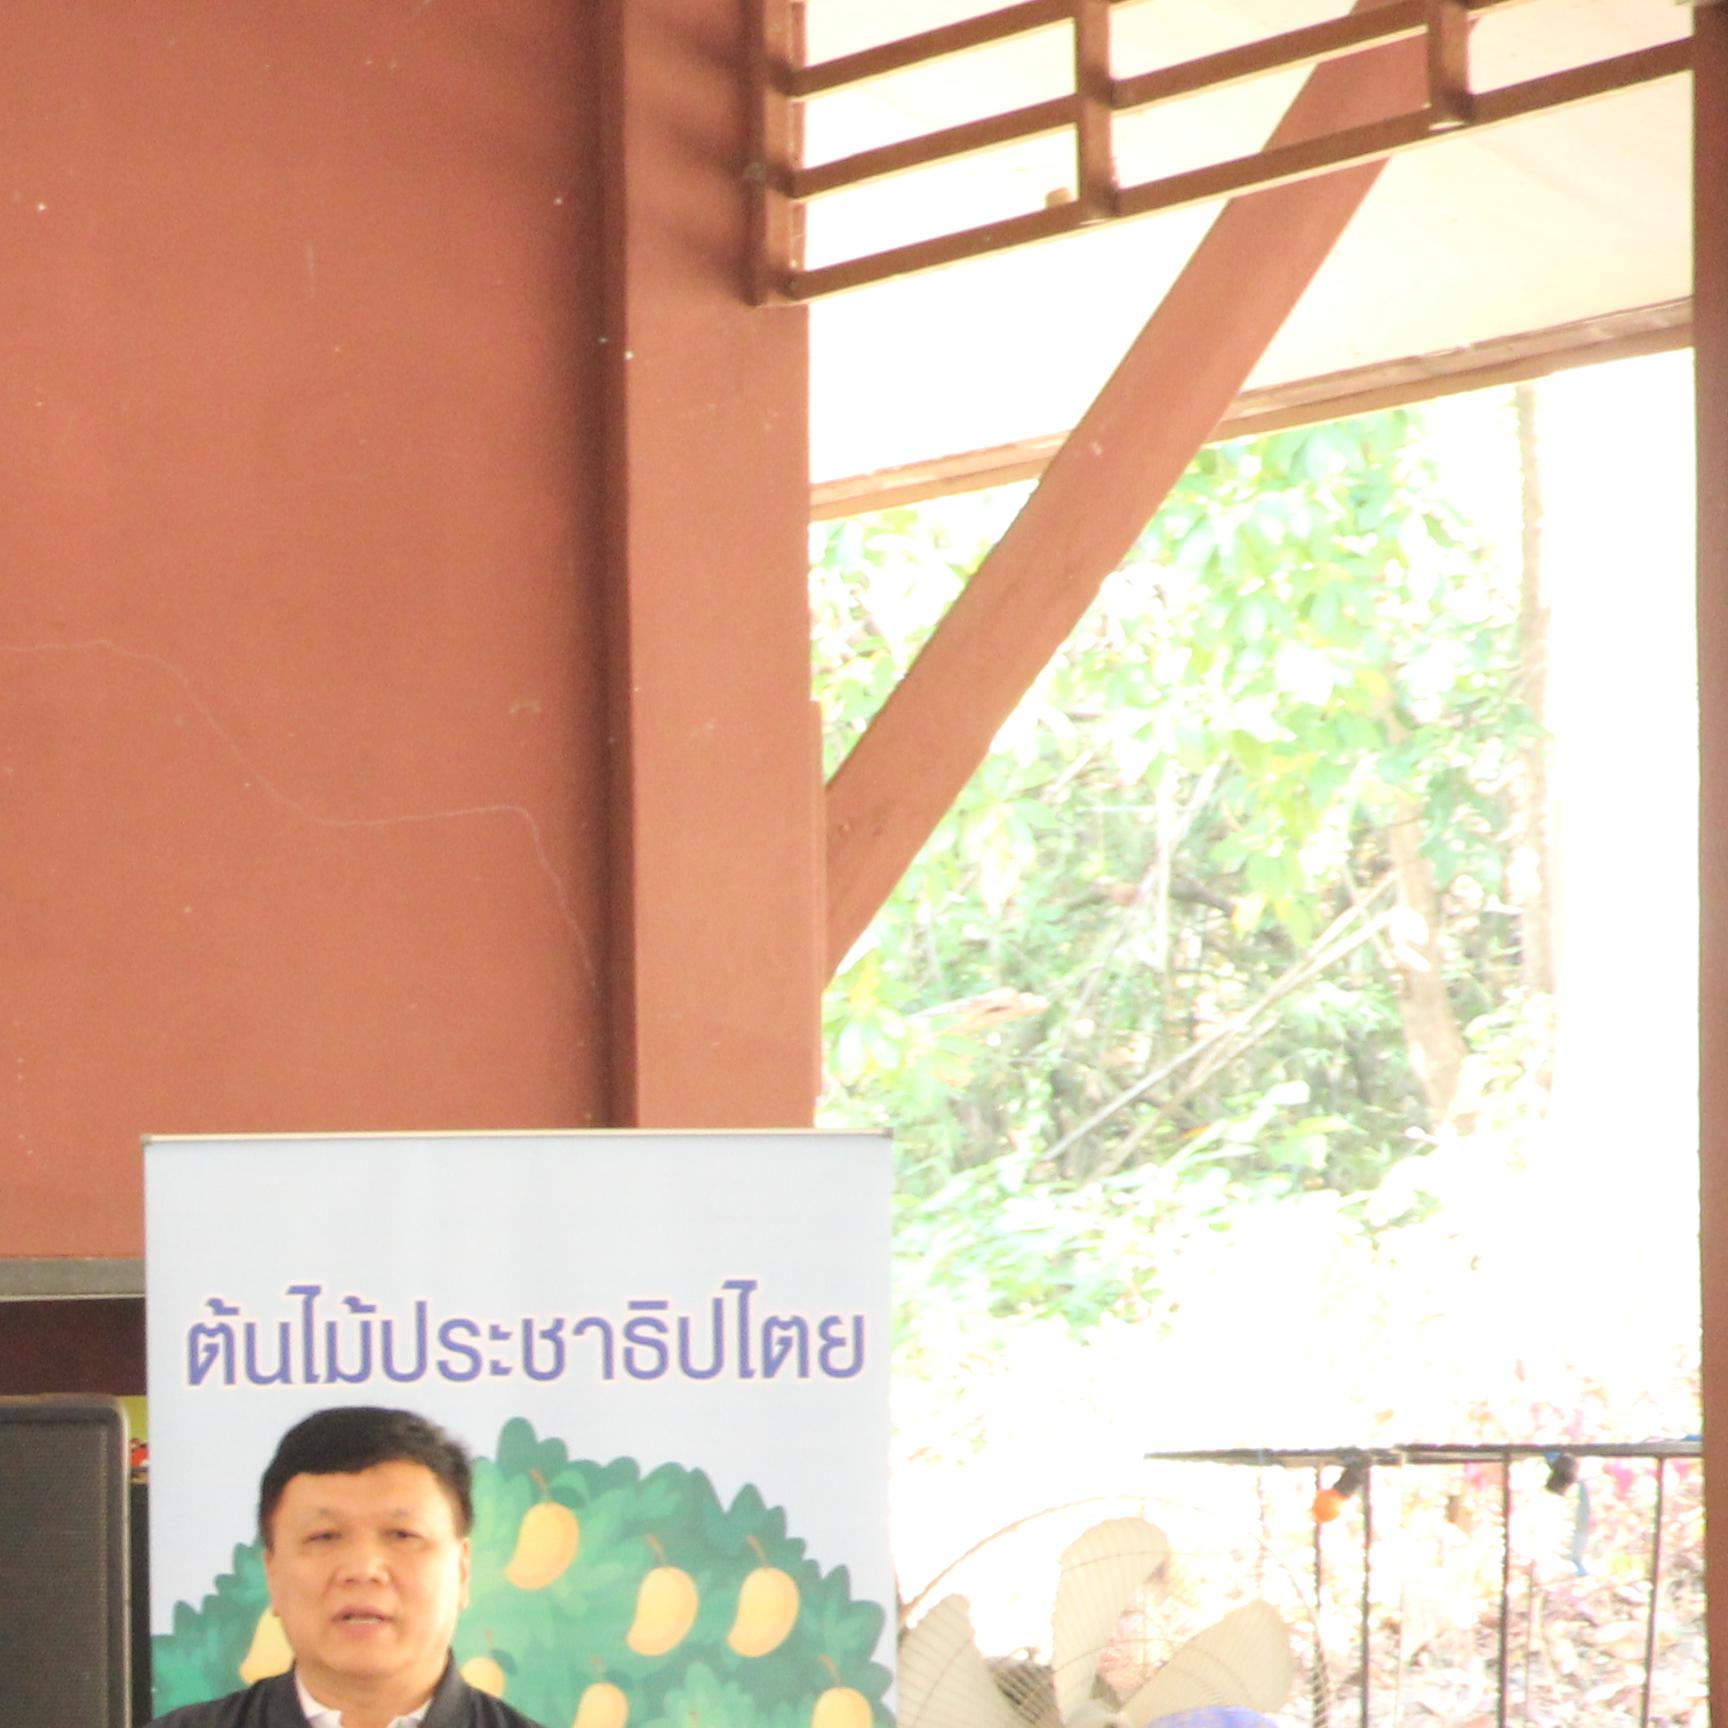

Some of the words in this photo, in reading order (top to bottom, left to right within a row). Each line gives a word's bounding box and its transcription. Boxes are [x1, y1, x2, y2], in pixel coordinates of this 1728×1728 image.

[186, 1279, 866, 1387] ต้นไม้ประชาธิปไตย
